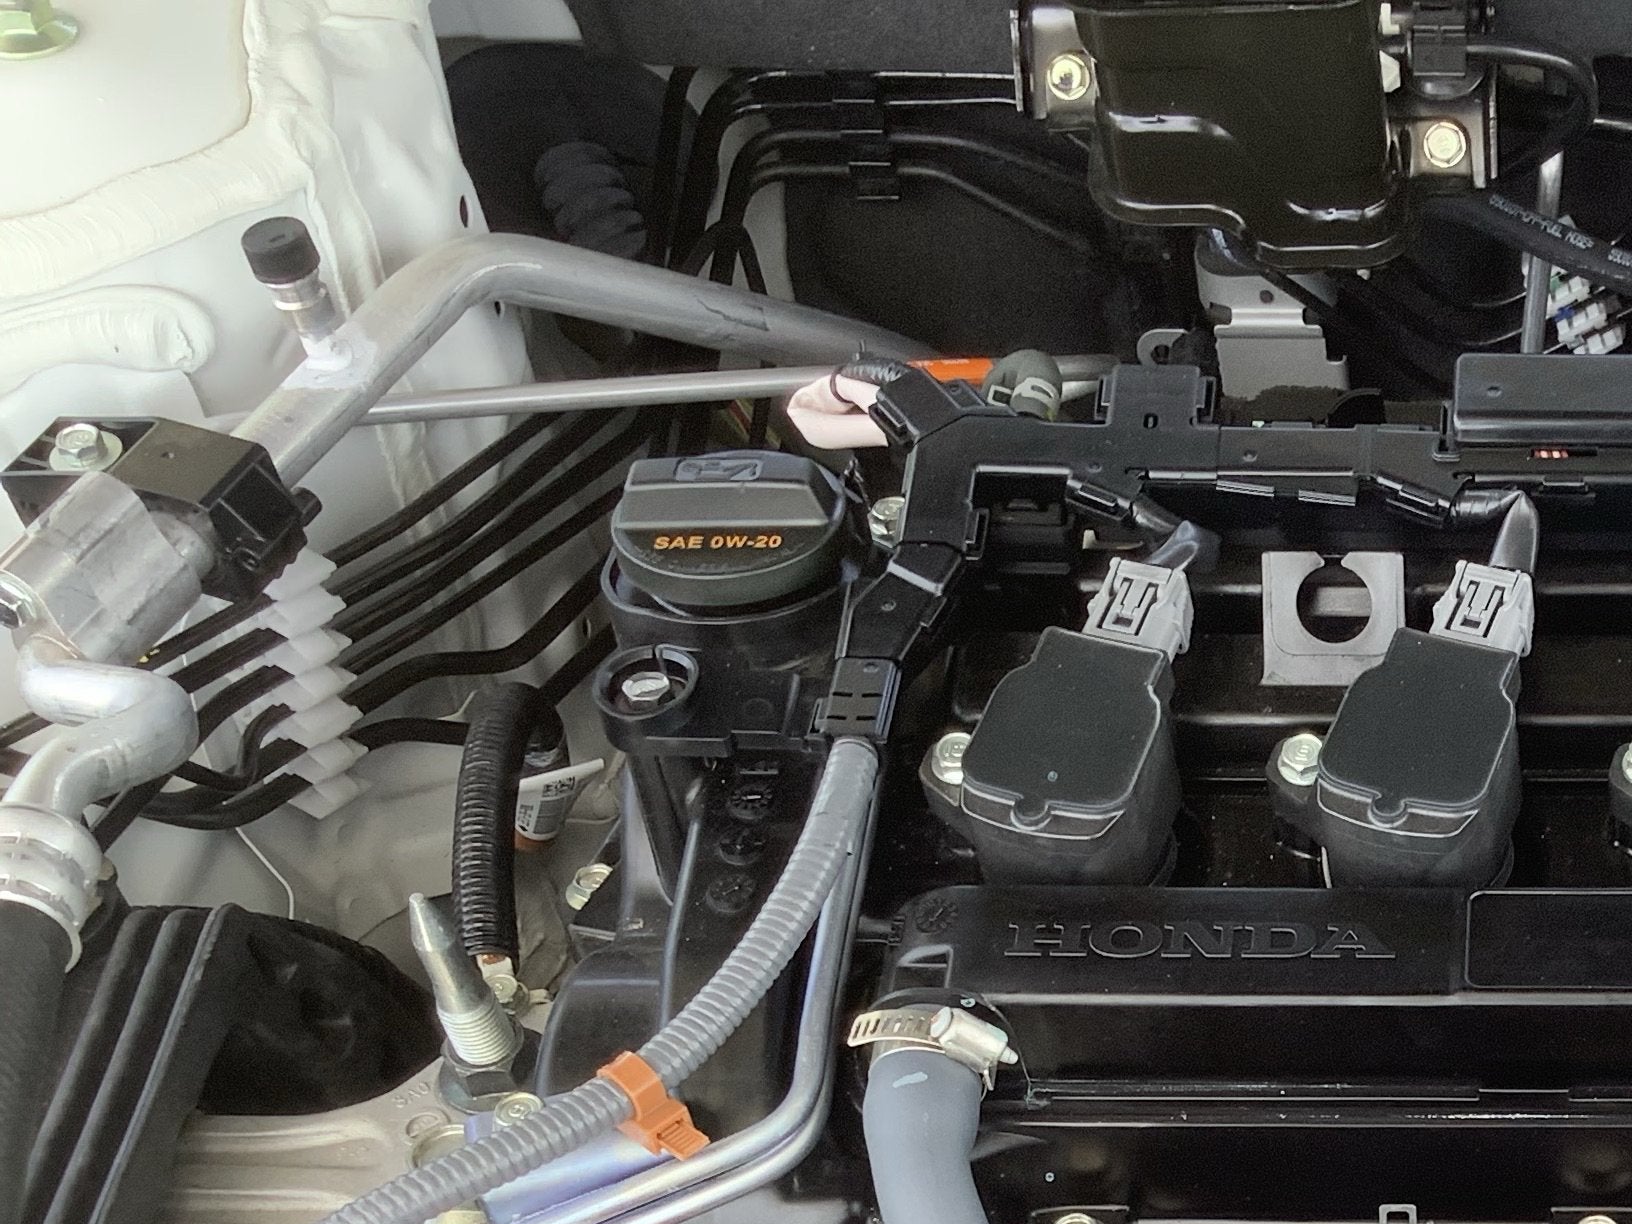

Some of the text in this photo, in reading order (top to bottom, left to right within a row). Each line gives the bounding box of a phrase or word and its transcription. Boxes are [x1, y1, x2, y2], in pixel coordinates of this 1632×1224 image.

[653, 534, 782, 550] SAE 0W-20
[1004, 921, 1396, 959] HONDA
